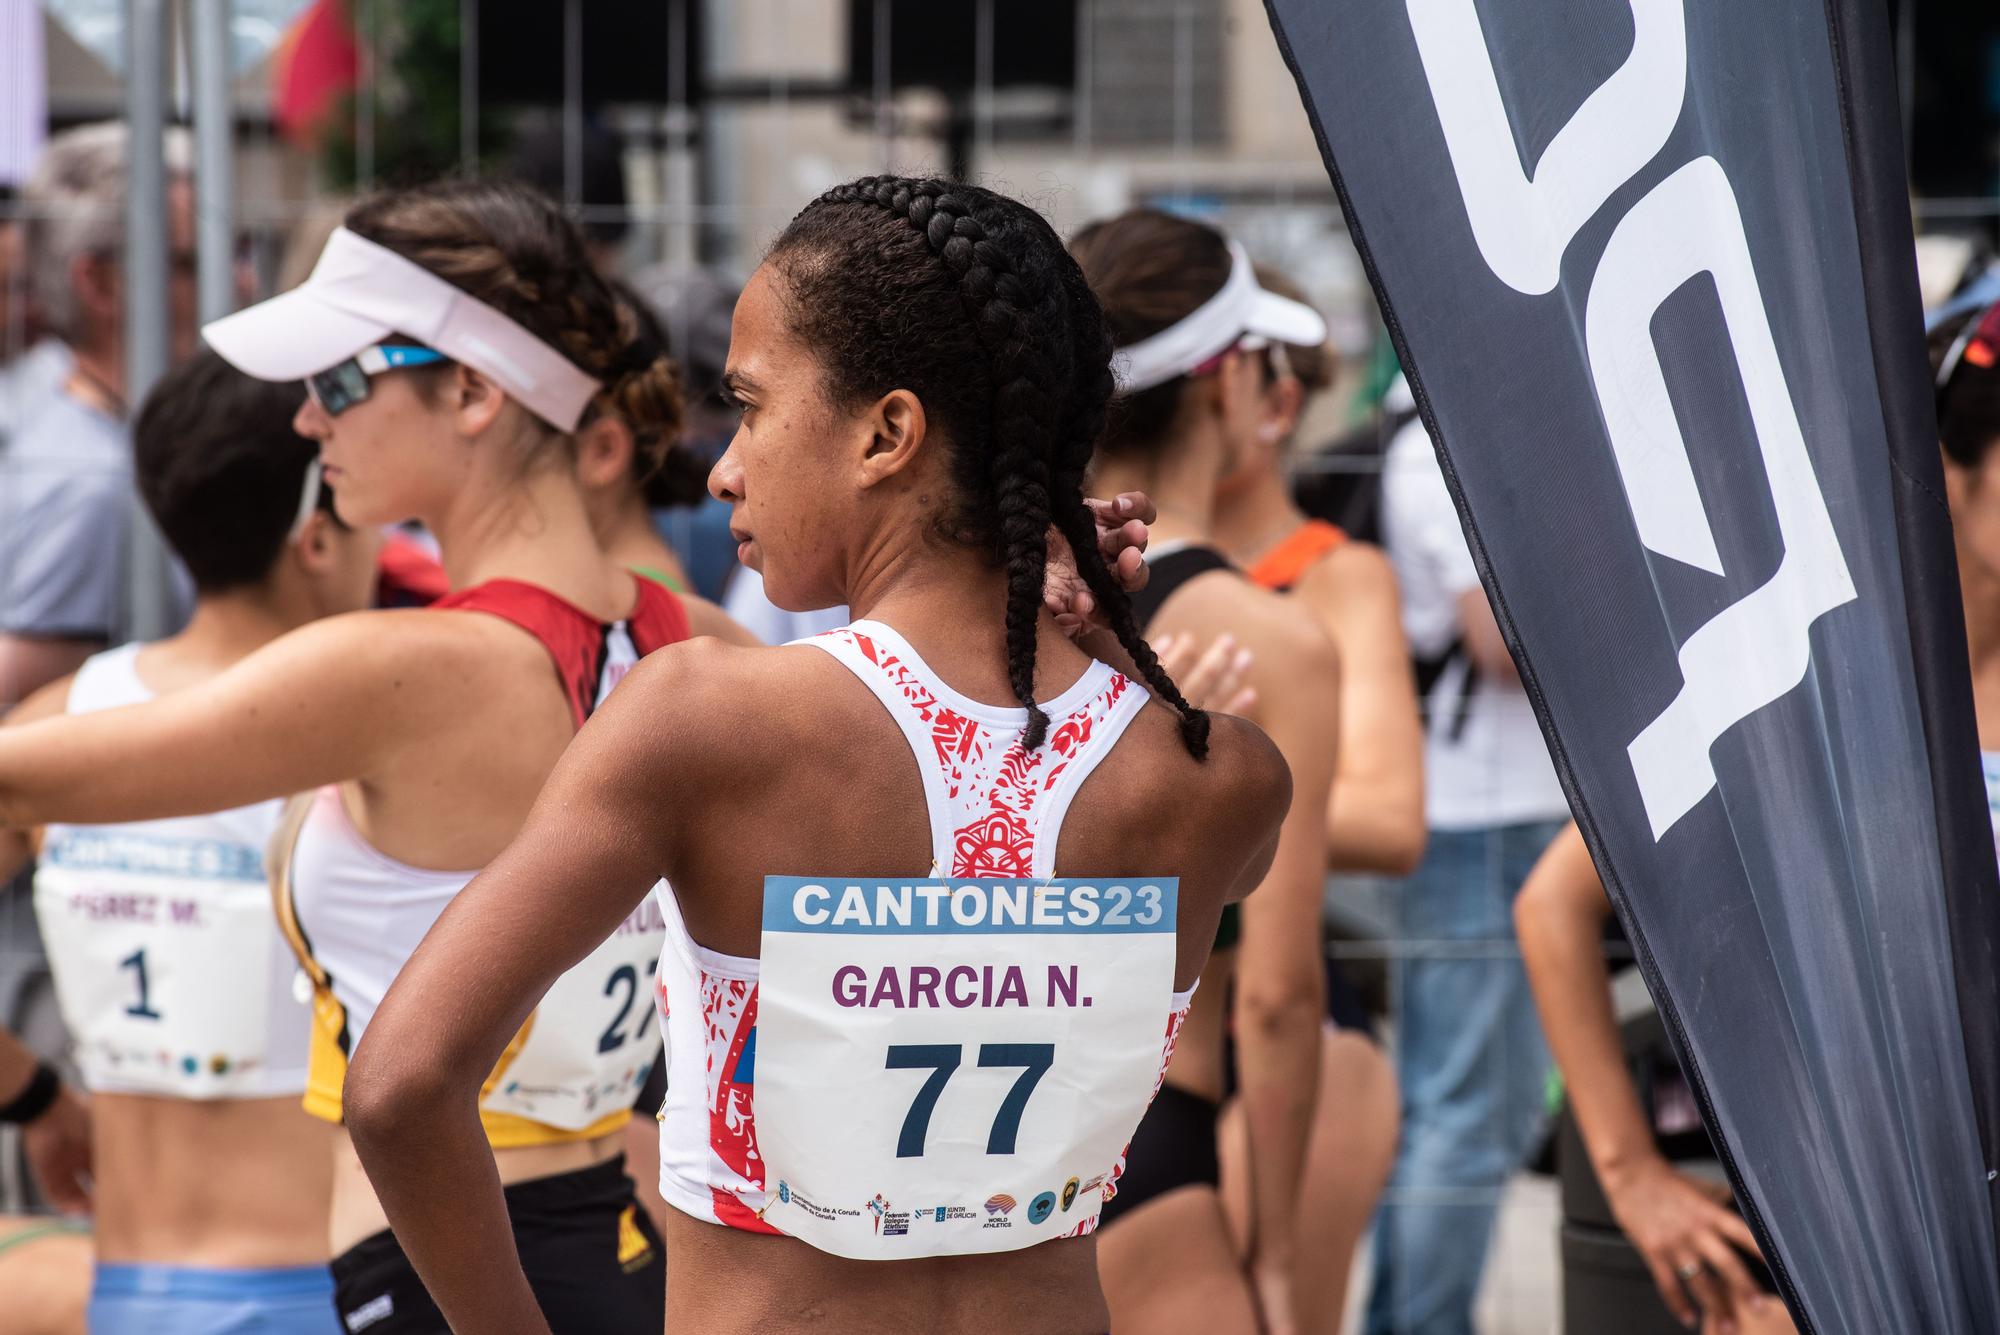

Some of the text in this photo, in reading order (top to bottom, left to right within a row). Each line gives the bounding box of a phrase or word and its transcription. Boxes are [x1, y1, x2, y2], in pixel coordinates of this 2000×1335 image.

[792, 885, 1163, 928] CANTONES23
[119, 946, 162, 1020] 1
[832, 964, 1093, 1009] GARCIA N.
[885, 1043, 1055, 1158] 77
[791, 1191, 822, 1212] Ayuntamiento
[822, 1206, 831, 1214] de
[838, 1208, 861, 1216] Coruña
[815, 1211, 836, 1221] Coruña
